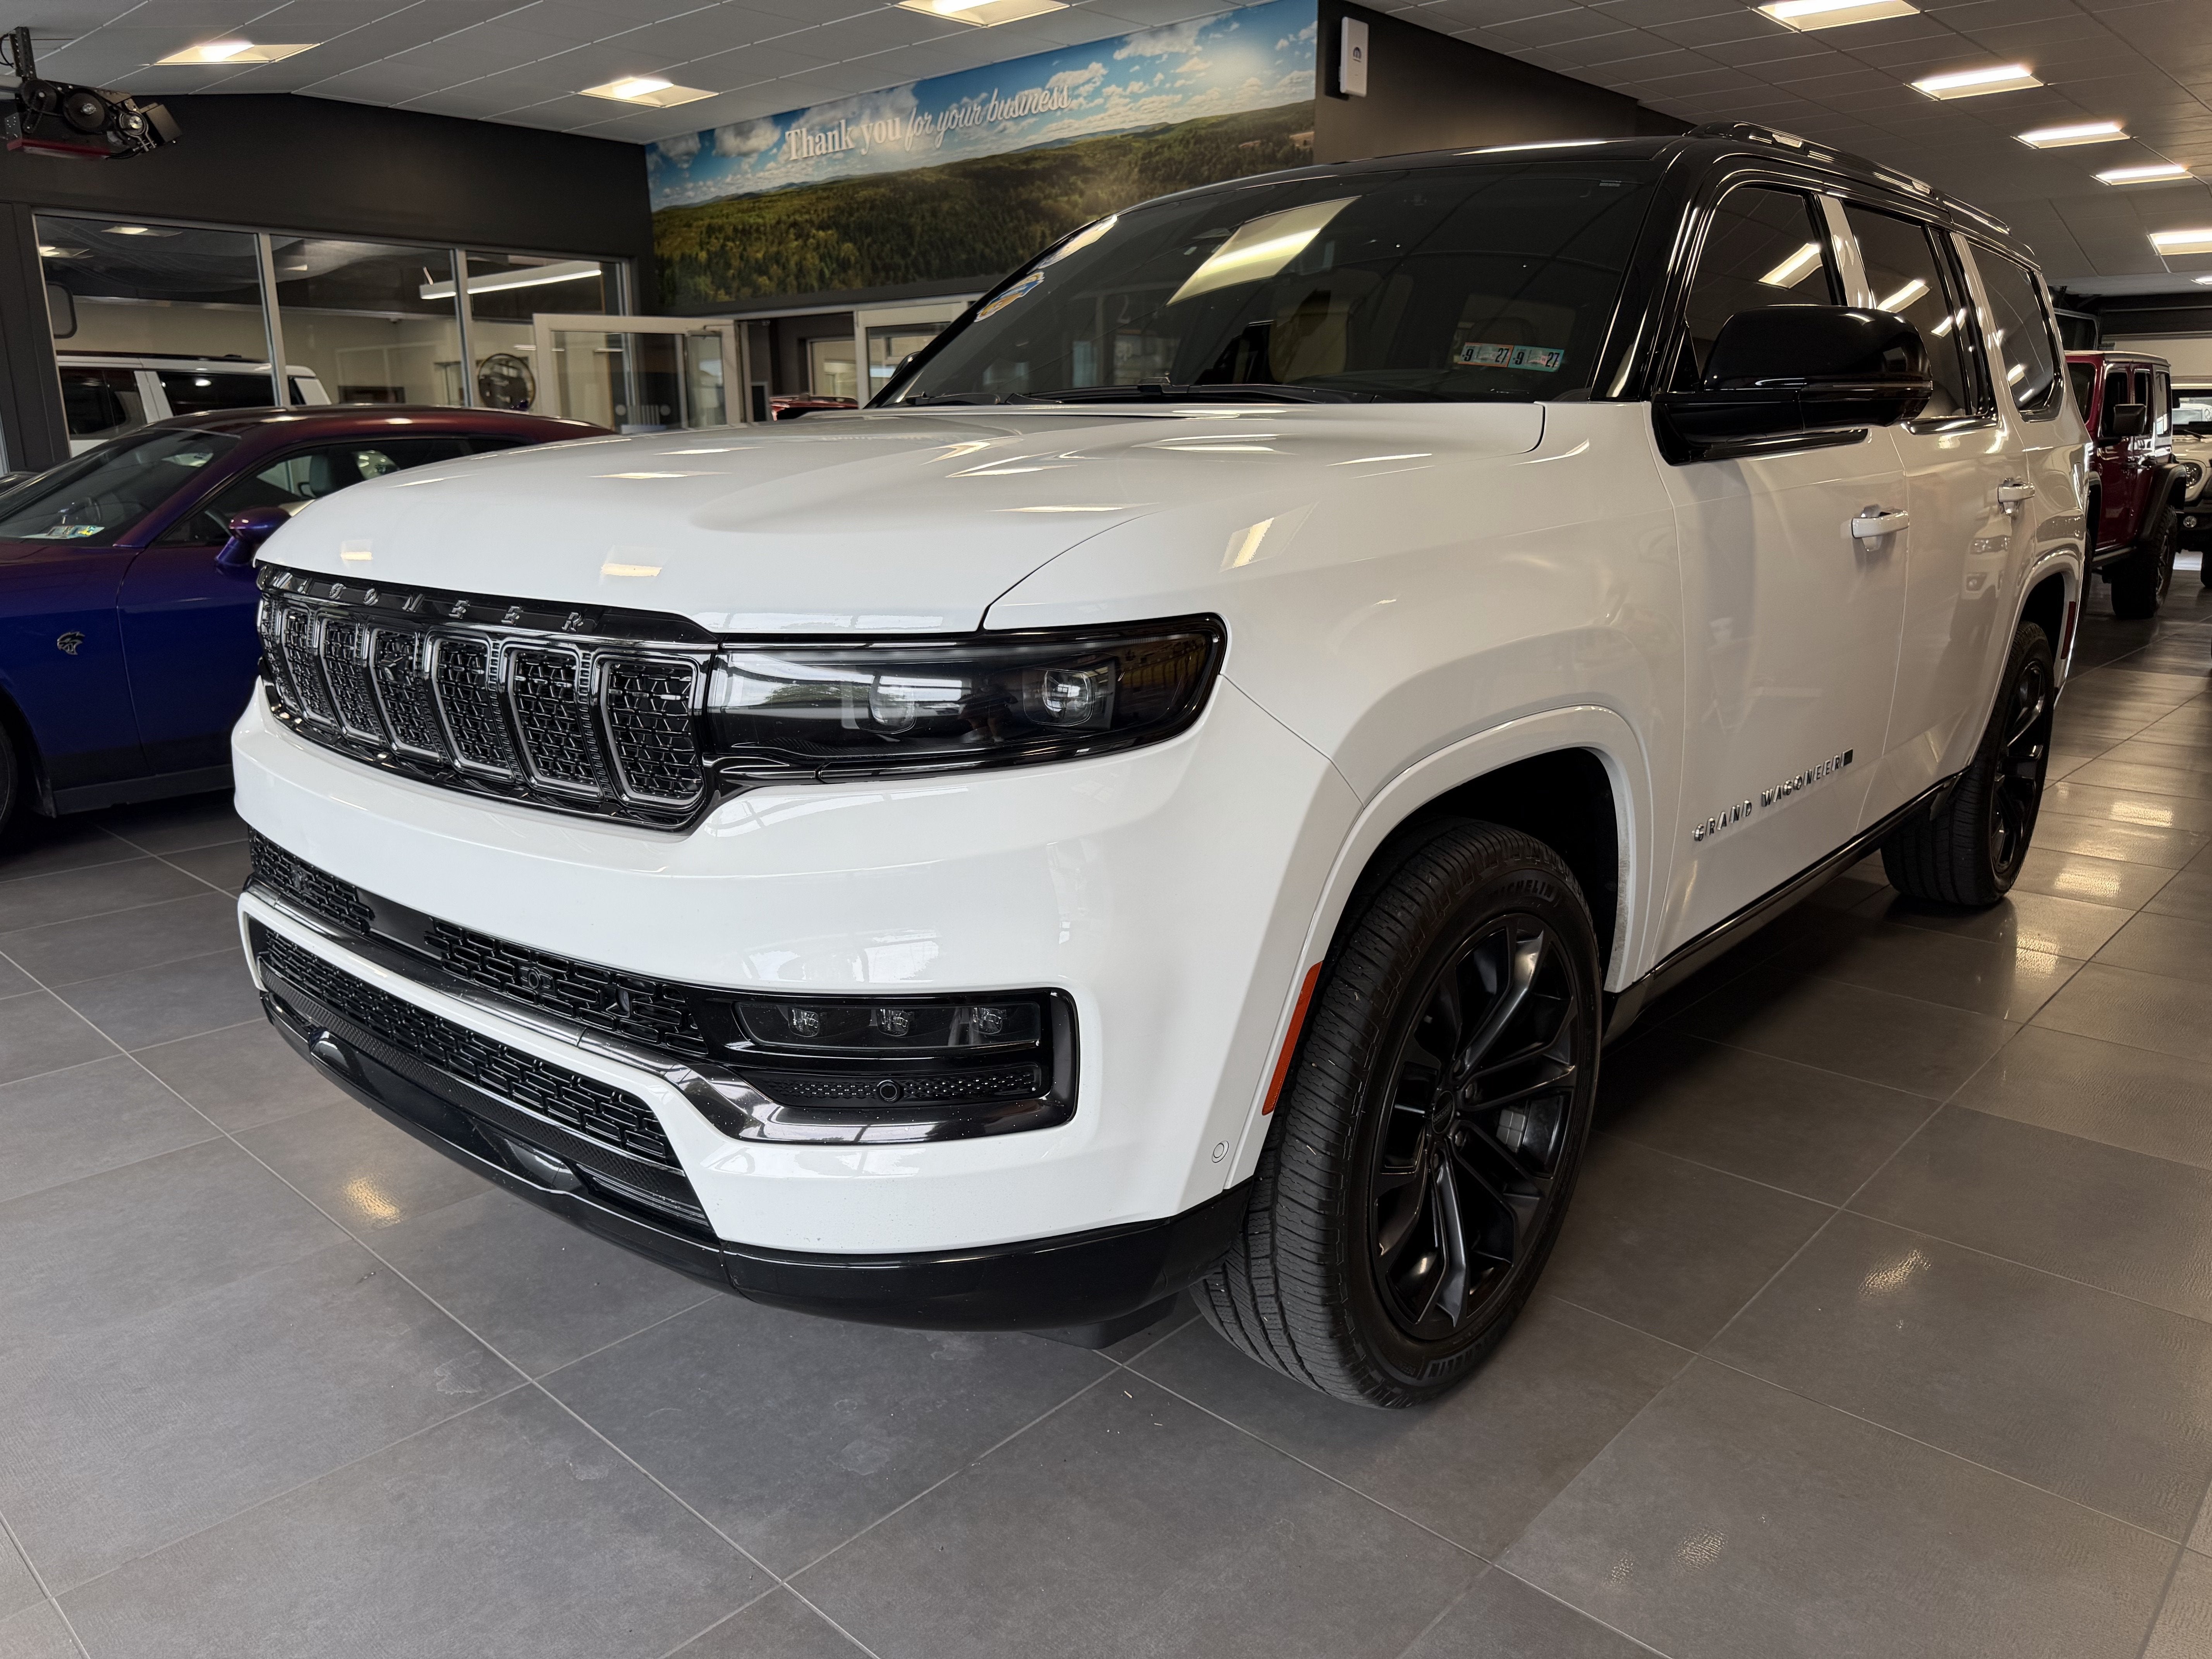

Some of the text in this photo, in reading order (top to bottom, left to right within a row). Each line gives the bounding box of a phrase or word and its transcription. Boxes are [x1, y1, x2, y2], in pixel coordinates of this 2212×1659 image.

[785, 86, 1072, 160] Thank you for your business
[1464, 347, 1510, 364] 9 27
[1515, 351, 1560, 368] 9 27
[1693, 755, 1841, 842] GRAND WAGONEER
